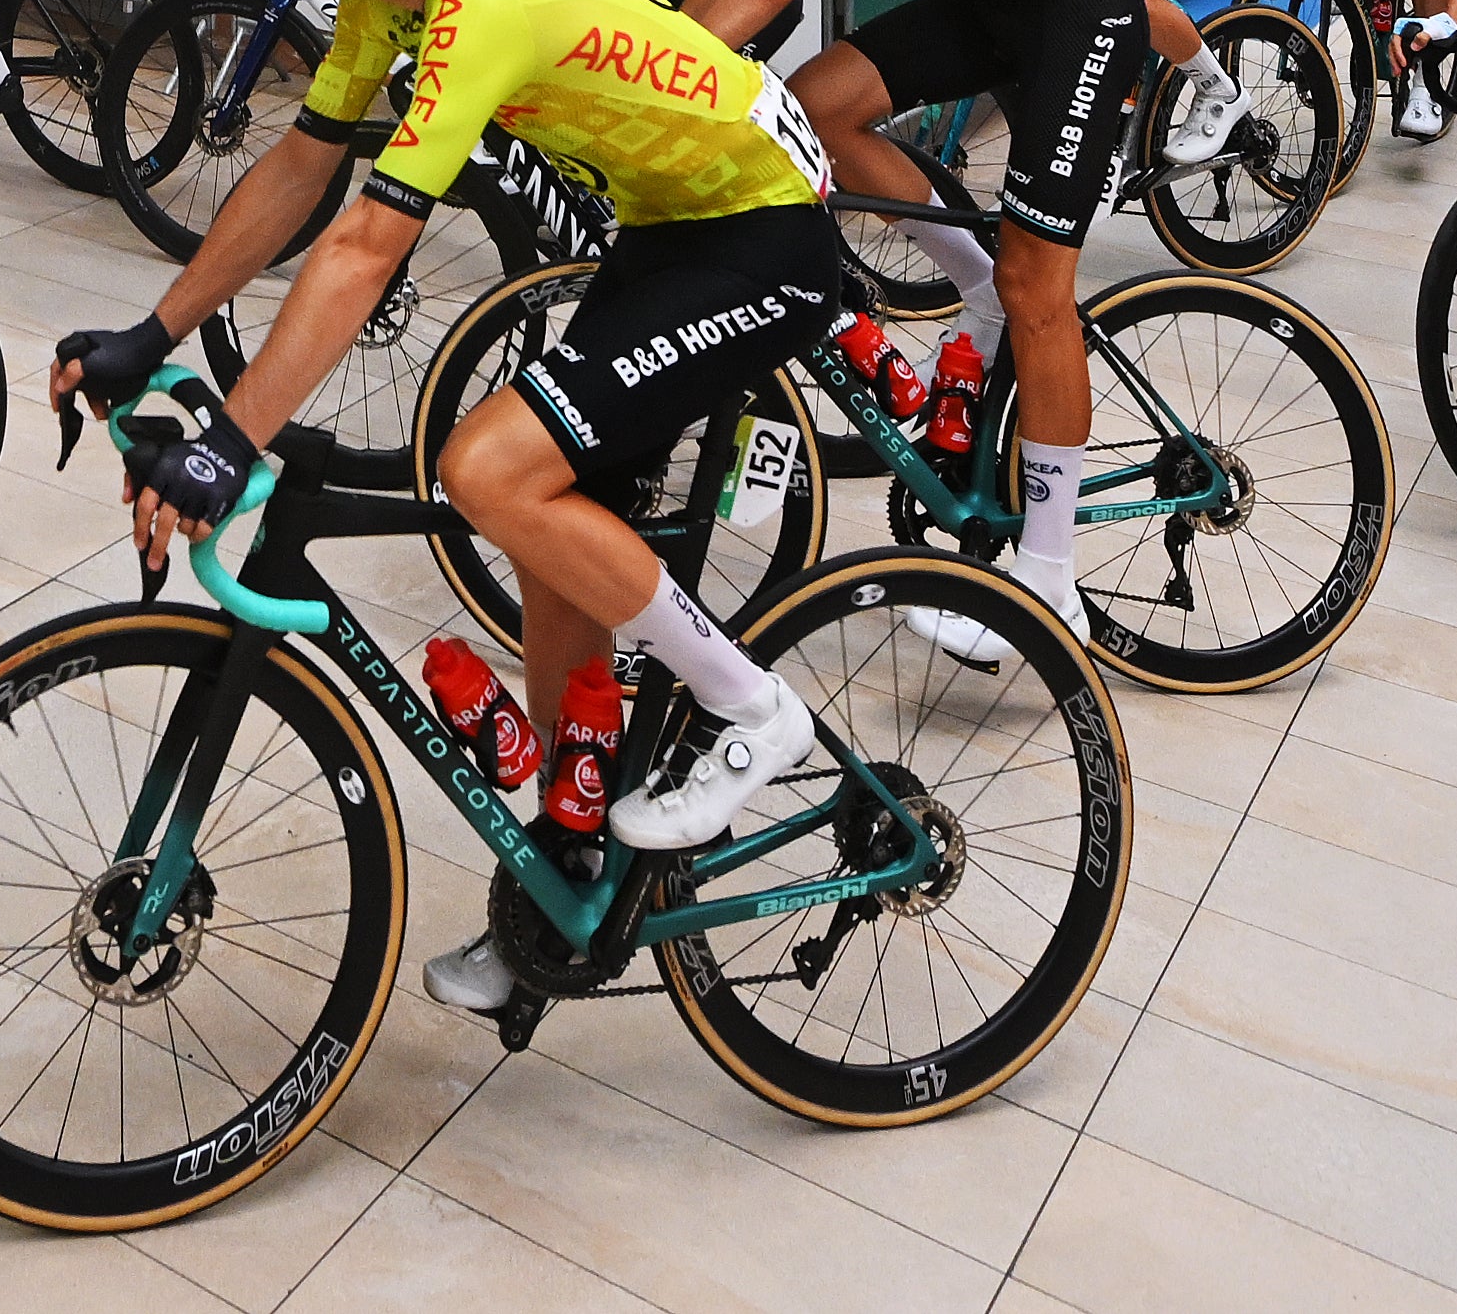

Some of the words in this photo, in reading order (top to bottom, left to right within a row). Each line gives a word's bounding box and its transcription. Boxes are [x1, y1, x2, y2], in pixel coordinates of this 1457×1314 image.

[555, 27, 720, 111] ARKEA
[1049, 124, 1085, 177] B&B
[1070, 35, 1116, 120] HOTELS
[1003, 190, 1076, 234] Bianchi
[611, 339, 679, 389] B&B
[681, 294, 787, 352] HOTELS
[526, 358, 601, 449] Bianchi
[850, 391, 913, 468] CORSE
[744, 428, 794, 495] 152
[1091, 500, 1177, 522] Bianchi
[335, 614, 447, 762] REPARTO
[451, 767, 537, 871] CORSE
[755, 879, 870, 918] Bianchi
